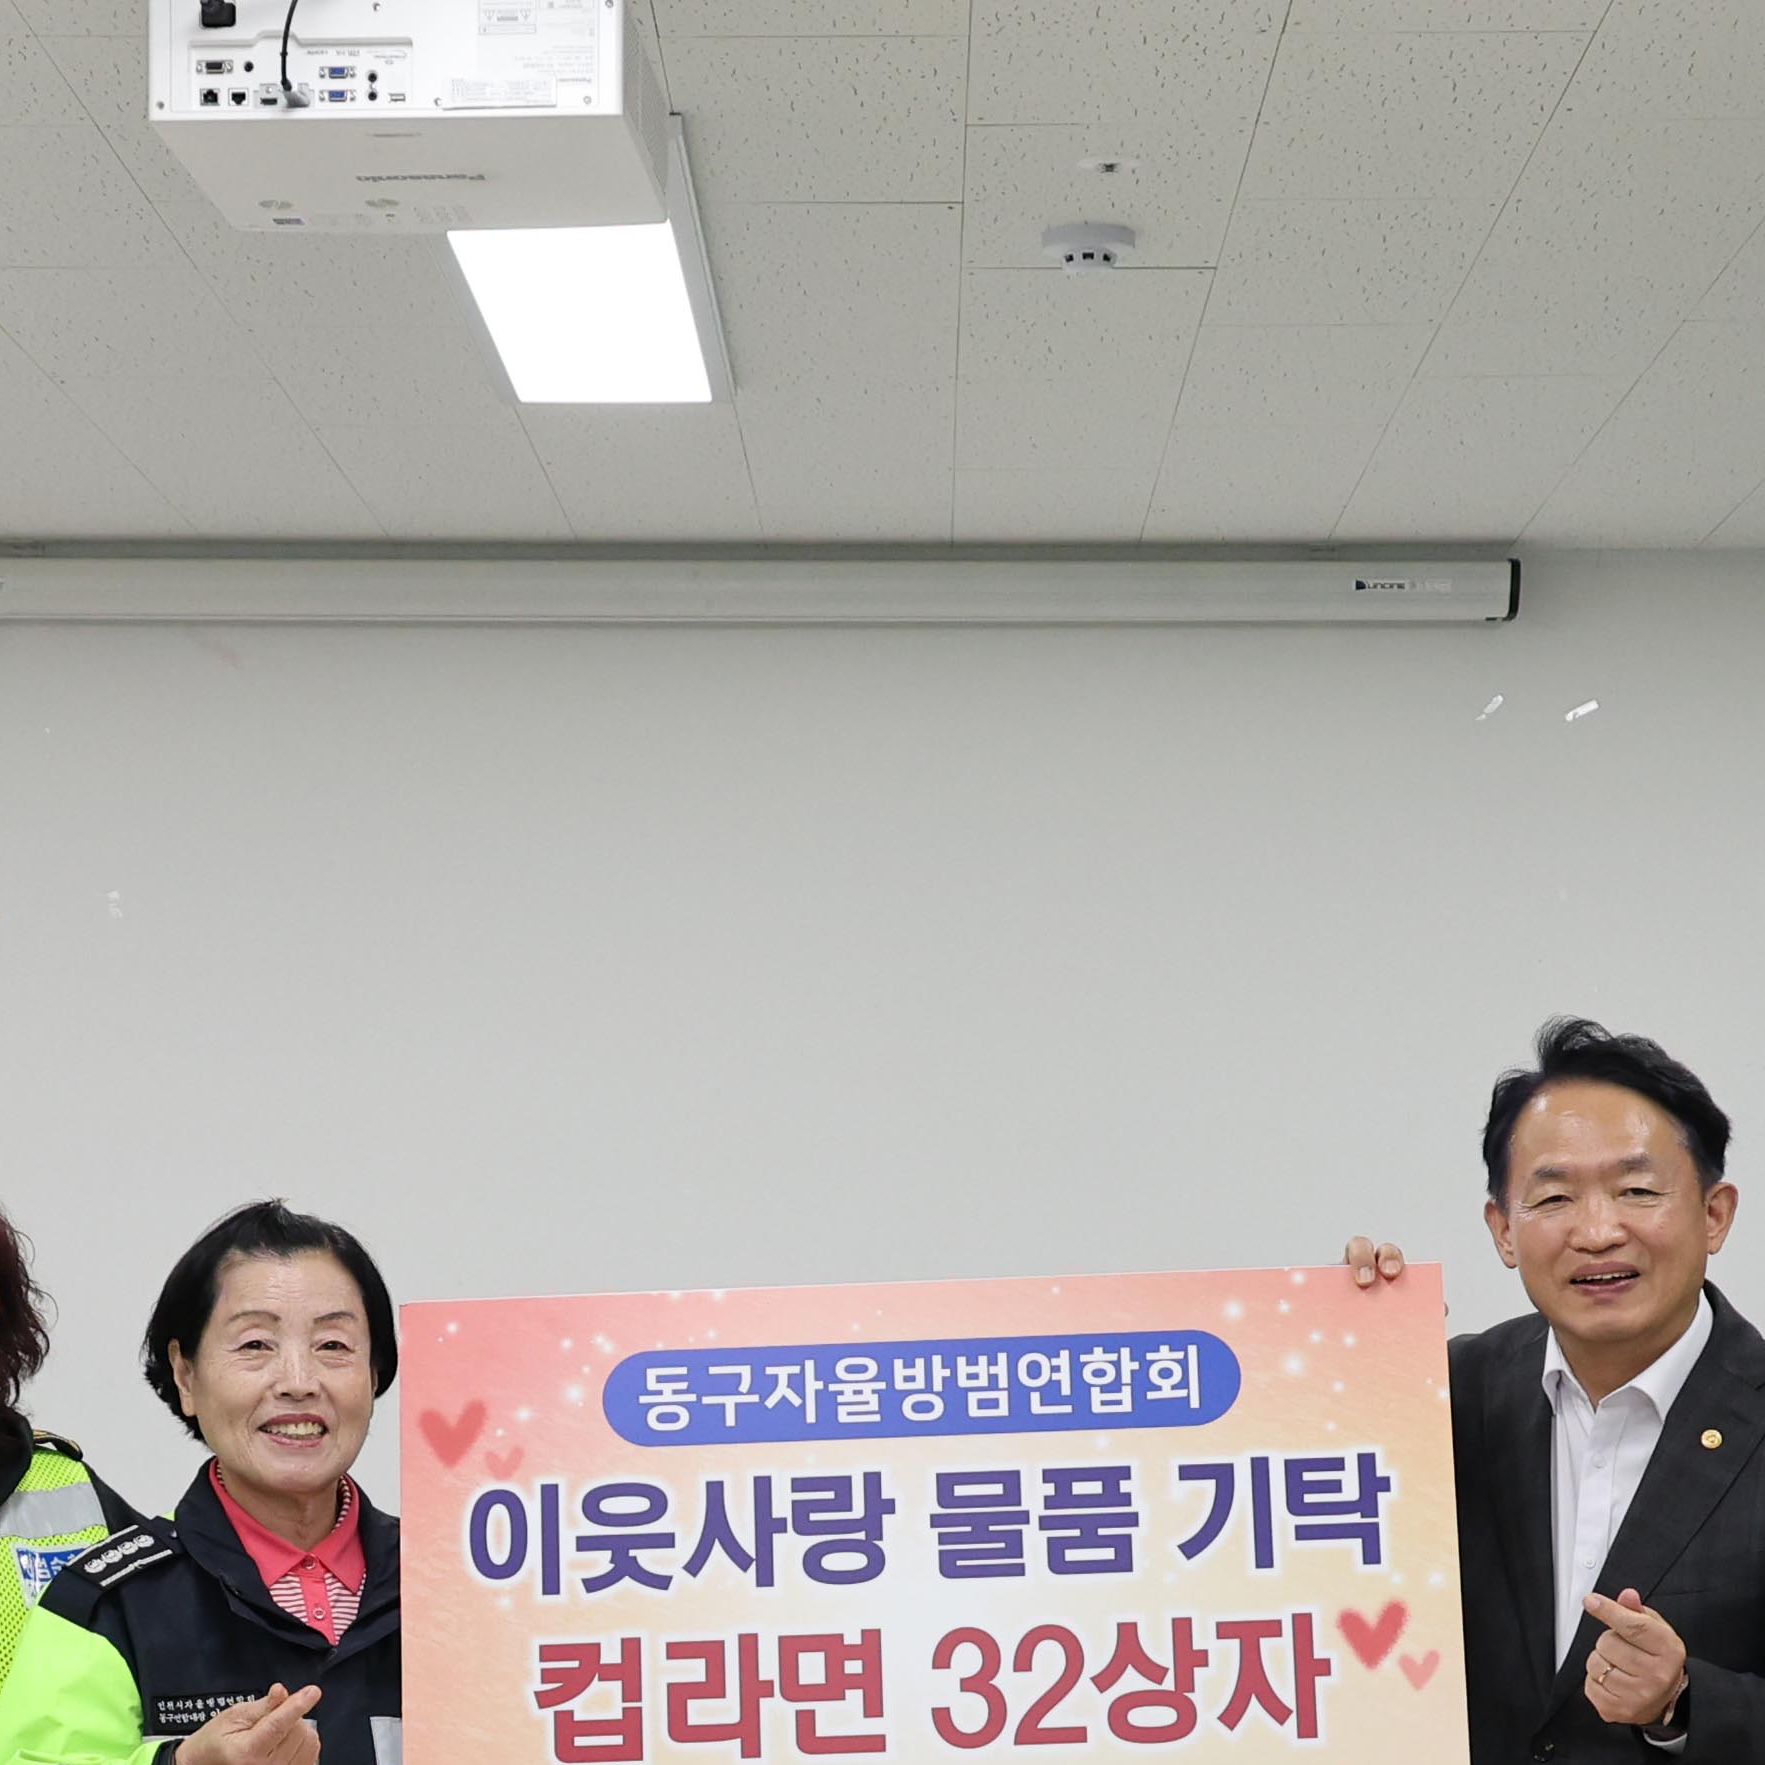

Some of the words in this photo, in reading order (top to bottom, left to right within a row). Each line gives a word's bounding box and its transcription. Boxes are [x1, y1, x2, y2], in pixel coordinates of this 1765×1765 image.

[637, 1344, 1201, 1432] 동구자율방범연합회
[468, 1470, 895, 1596] 이웃사랑
[929, 1465, 1140, 1582] 물품
[1176, 1452, 1391, 1570] 기탁
[534, 1627, 887, 1765] 컵라면
[930, 1612, 1333, 1747] 32상자
